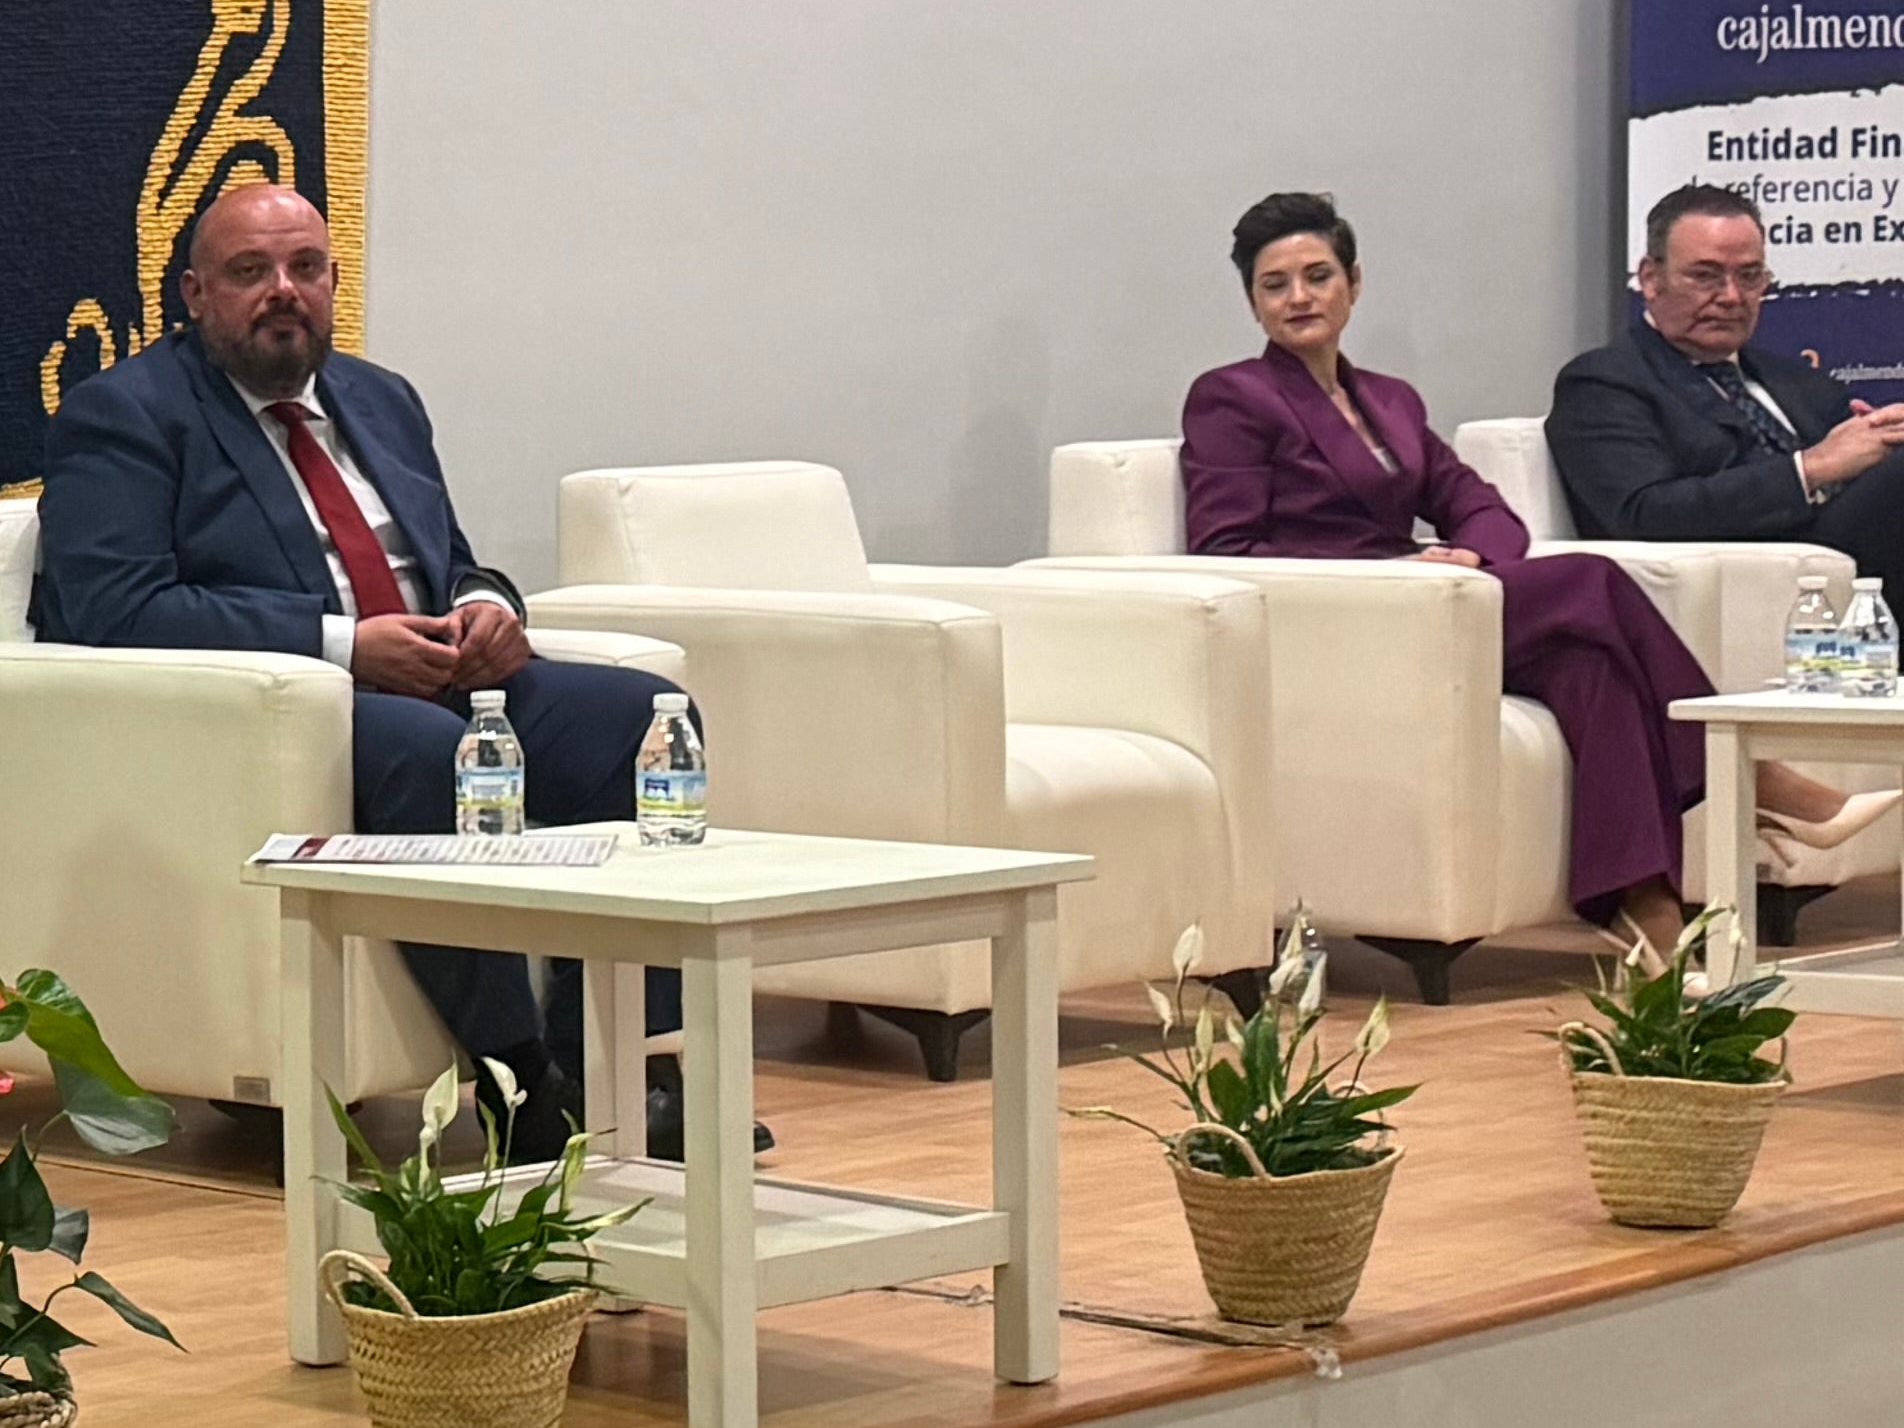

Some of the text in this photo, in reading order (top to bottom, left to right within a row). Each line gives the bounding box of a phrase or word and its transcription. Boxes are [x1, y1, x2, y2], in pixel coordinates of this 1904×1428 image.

[1708, 125, 1904, 161] Entidad Fin
[1882, 178, 1899, 208] y
[1824, 221, 1862, 243] en
